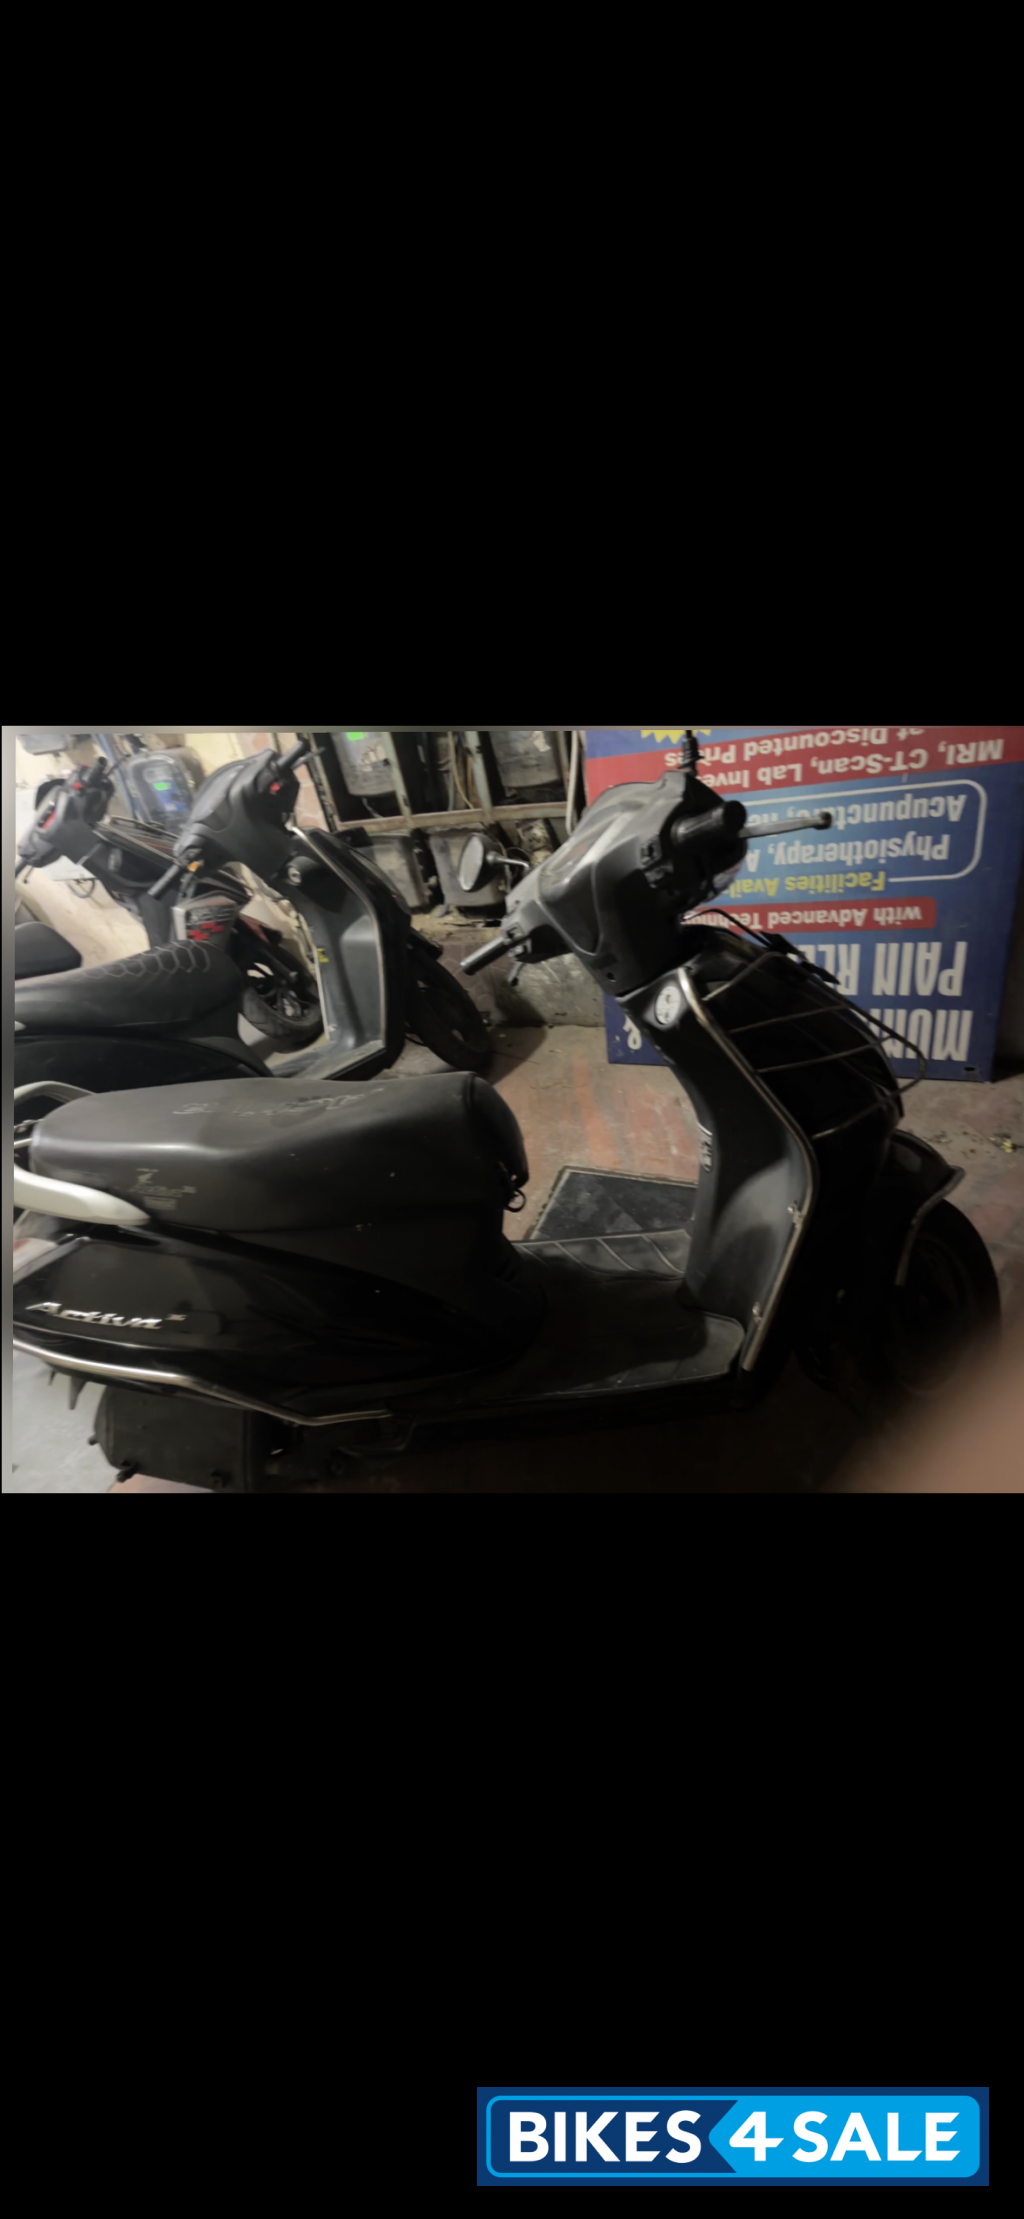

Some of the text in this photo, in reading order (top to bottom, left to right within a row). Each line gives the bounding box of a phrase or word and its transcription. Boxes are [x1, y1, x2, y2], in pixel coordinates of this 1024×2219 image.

[744, 728, 888, 762] Discounted
[938, 739, 1004, 765] MRI,
[759, 763, 803, 783] Lab
[811, 748, 929, 775] CT-Scan,
[786, 795, 968, 830] Acupunct,
[745, 830, 950, 872] Physiotherapy, A
[728, 871, 886, 899] Facilities Avail
[768, 907, 868, 928] Advanced
[874, 906, 923, 926] with
[872, 941, 969, 997] PAIN
